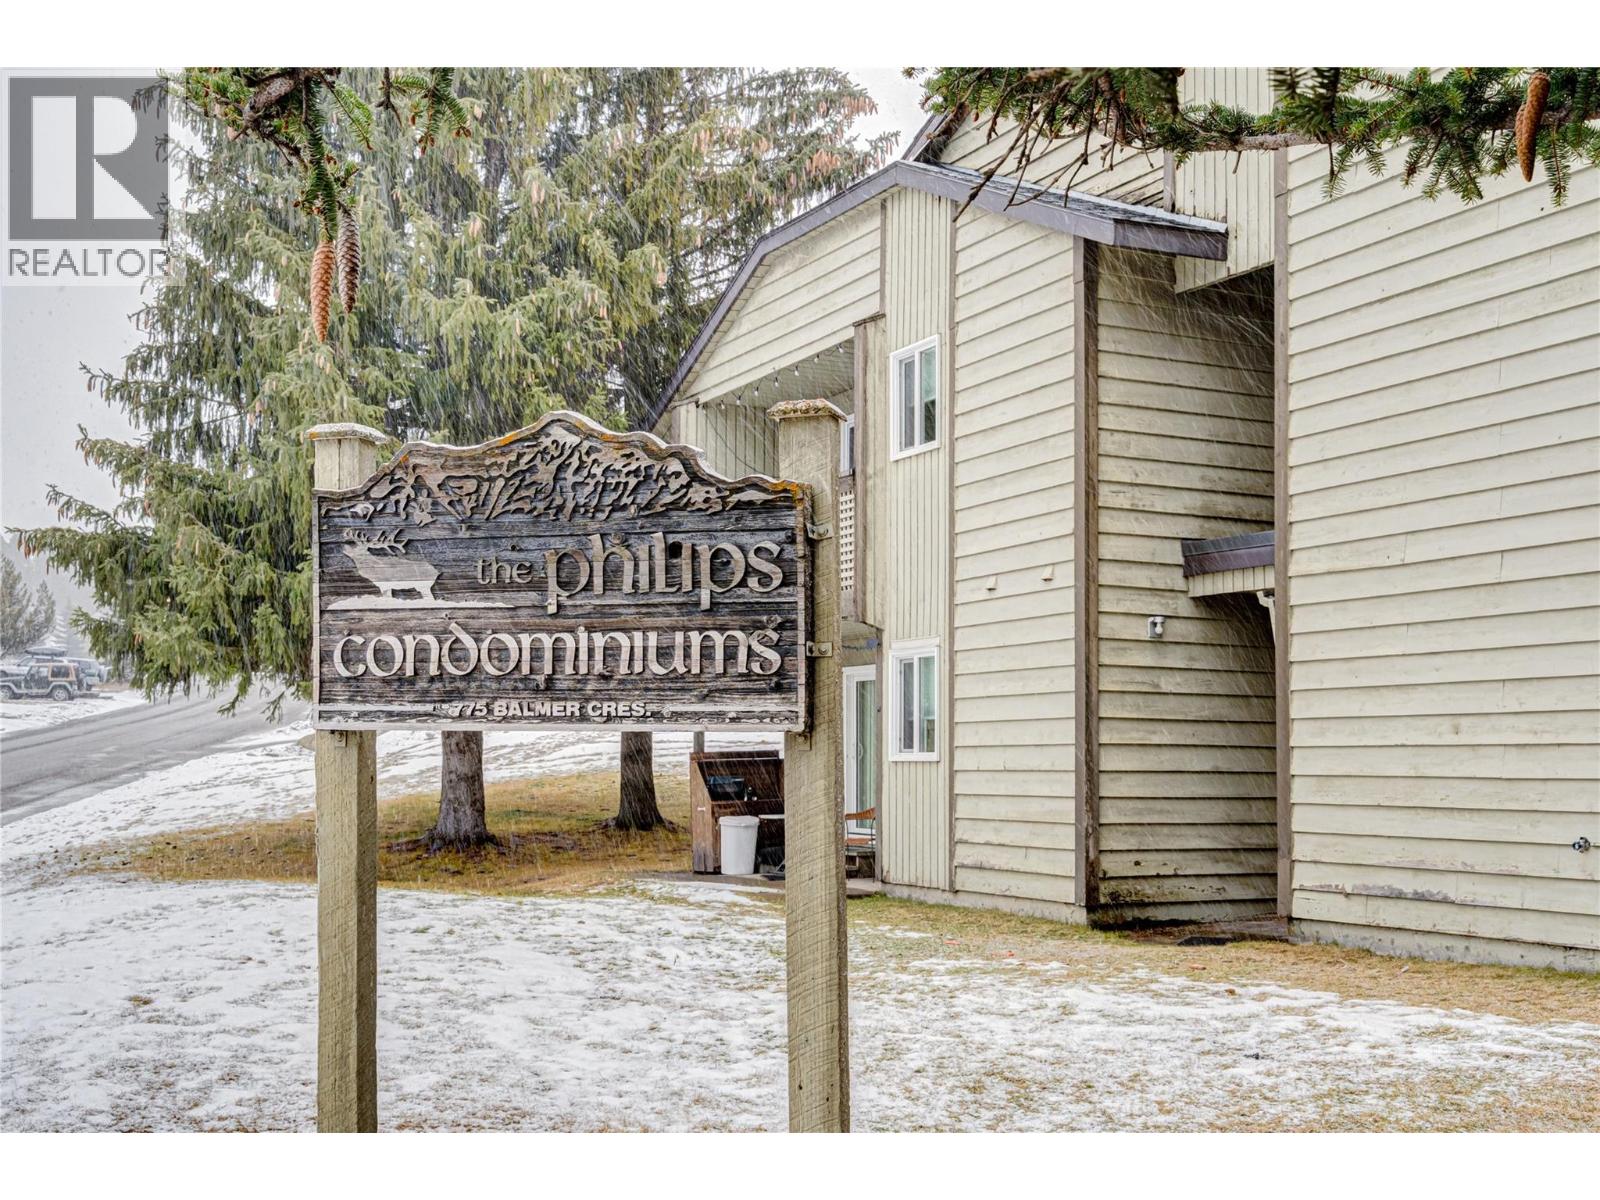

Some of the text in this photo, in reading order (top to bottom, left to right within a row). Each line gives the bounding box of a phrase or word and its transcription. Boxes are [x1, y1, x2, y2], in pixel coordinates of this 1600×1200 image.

[475, 555, 532, 584] the
[333, 620, 782, 677] condominiums
[449, 701, 652, 717] 775 BALMER CRES.
